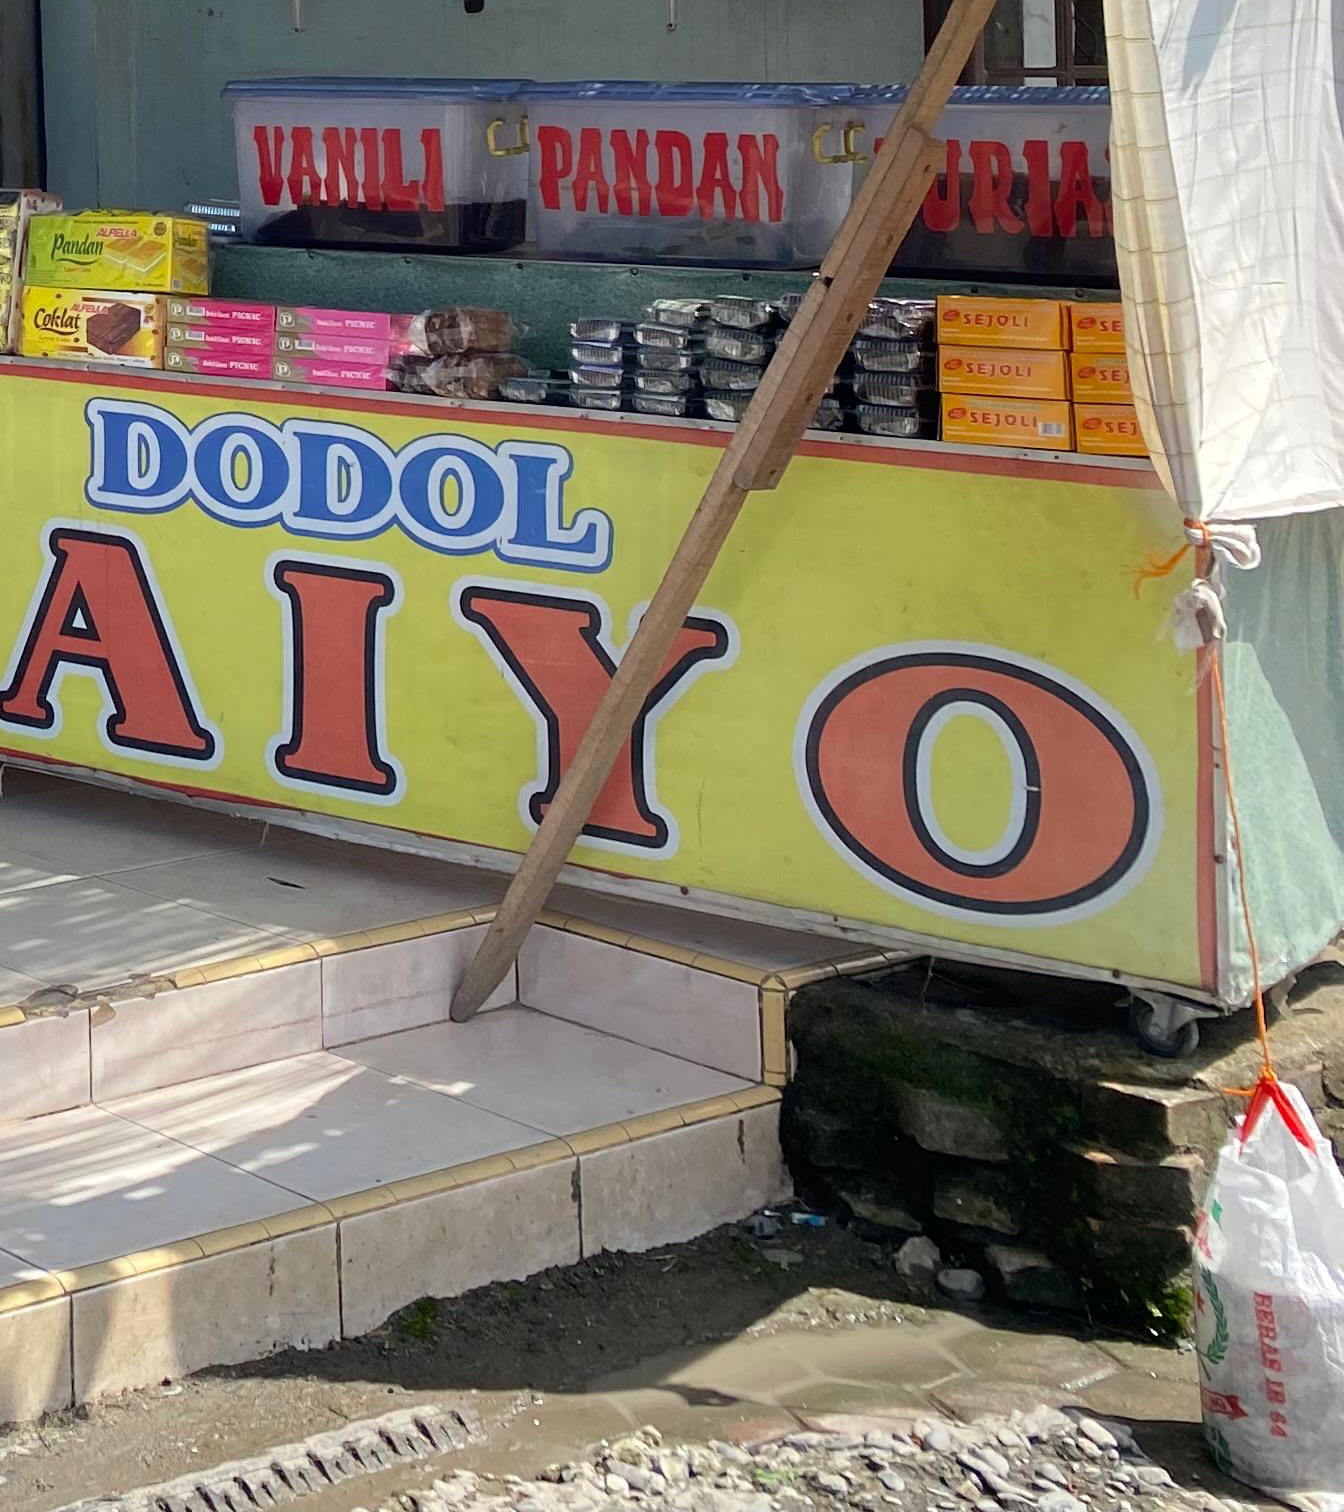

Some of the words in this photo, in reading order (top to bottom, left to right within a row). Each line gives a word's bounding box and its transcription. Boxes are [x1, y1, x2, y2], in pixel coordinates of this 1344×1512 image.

[253, 124, 446, 214] VANILI
[538, 124, 786, 224] PANDAN
[873, 137, 1113, 239] URIA
[96, 228, 140, 239] ALPELLA
[50, 233, 104, 261] Pandan
[70, 303, 110, 314] ALPELLA
[231, 311, 261, 321] PICNIC
[33, 307, 81, 331] Coklat
[963, 312, 1030, 328] SEJOLI
[231, 336, 262, 346] PICNIC
[229, 361, 260, 371] PICNIC
[966, 362, 1032, 377] SEJOLI
[1099, 366, 1131, 382] SEJ
[340, 370, 373, 380] PICNIC
[970, 411, 1038, 428] SEJOLI
[1104, 420, 1138, 435] SEJ
[88, 398, 612, 571] DODOL
